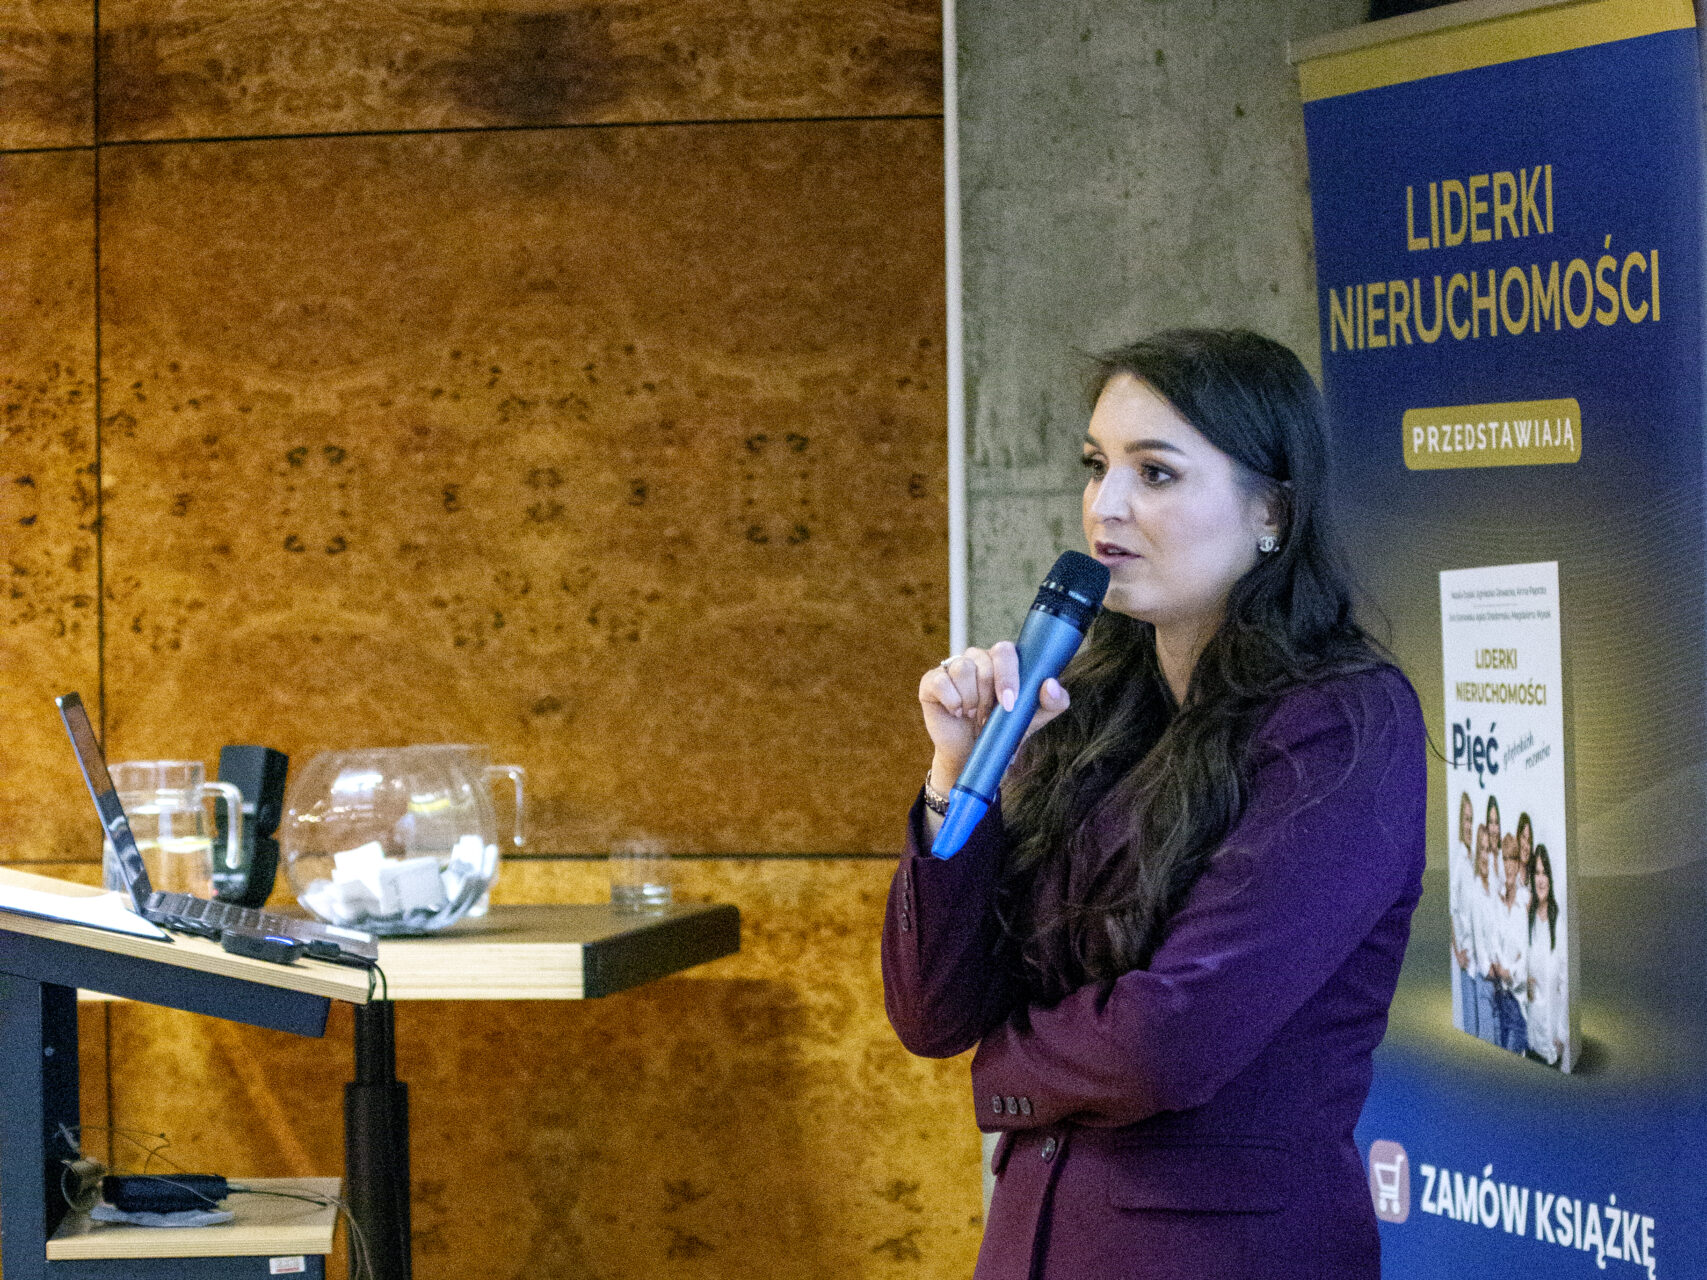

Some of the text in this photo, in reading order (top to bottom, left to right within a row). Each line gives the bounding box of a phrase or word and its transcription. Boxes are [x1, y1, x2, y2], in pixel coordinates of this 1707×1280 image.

[1406, 164, 1554, 251] LIDERKI
[1329, 234, 1661, 352] NIERUCHOMOŚCI
[1413, 417, 1575, 452] PRZEDSTAWIAJĄ
[1455, 678, 1547, 706] NIERUCHOMOŚCI
[1475, 648, 1518, 670] LIDERKI
[1452, 718, 1499, 789] Pięć
[1420, 1163, 1529, 1236] ZAMÓW
